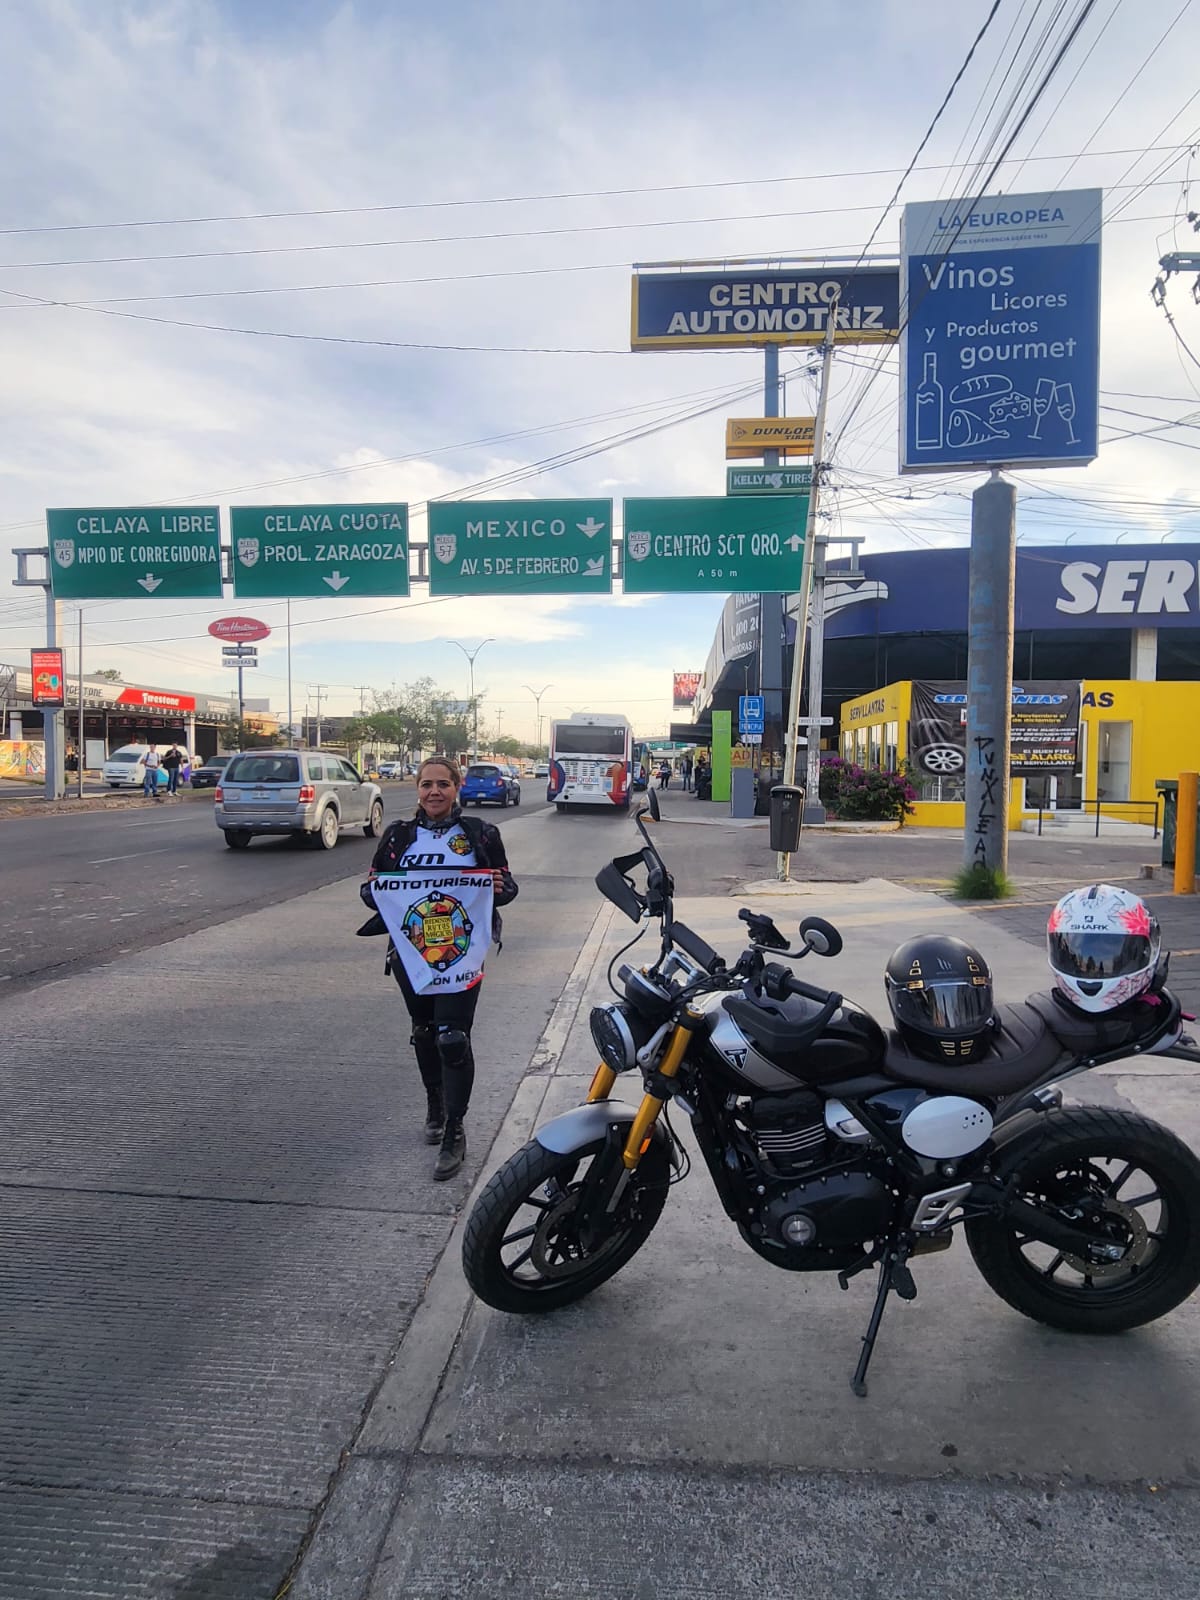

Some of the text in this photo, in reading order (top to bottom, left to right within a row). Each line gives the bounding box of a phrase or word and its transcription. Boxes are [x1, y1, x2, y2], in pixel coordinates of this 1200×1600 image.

[938, 208, 1064, 230] LA EUROPEA
[922, 262, 1014, 290] Vinos
[709, 281, 842, 307] CENTRO
[991, 292, 1067, 311] Licores
[667, 305, 884, 334] AUTOMOTRIZ
[925, 319, 1038, 343] y Productos
[959, 337, 1077, 369] gourmet
[752, 427, 814, 436] DUNLOP
[733, 474, 765, 485] KELLY
[77, 515, 216, 534] CELAYA LIBRE
[265, 513, 403, 532] CELAYA CUOTA
[466, 519, 566, 539] MEXICO
[78, 545, 217, 563] MPIO DE CORREGIDORA
[264, 543, 406, 562] PROL. ZARAGOZA
[439, 545, 452, 557] 57
[633, 543, 647, 554] 45
[654, 533, 783, 557] CENTRO SCT QRO.
[58, 550, 71, 561] 45
[460, 556, 579, 575] AV. 5 DE FEBRERO
[698, 569, 705, 577] A
[711, 569, 723, 577] 50
[1055, 559, 1200, 615] SER
[849, 699, 885, 720] SERVILLANTAS
[374, 876, 492, 891] MOTOTURISMO
